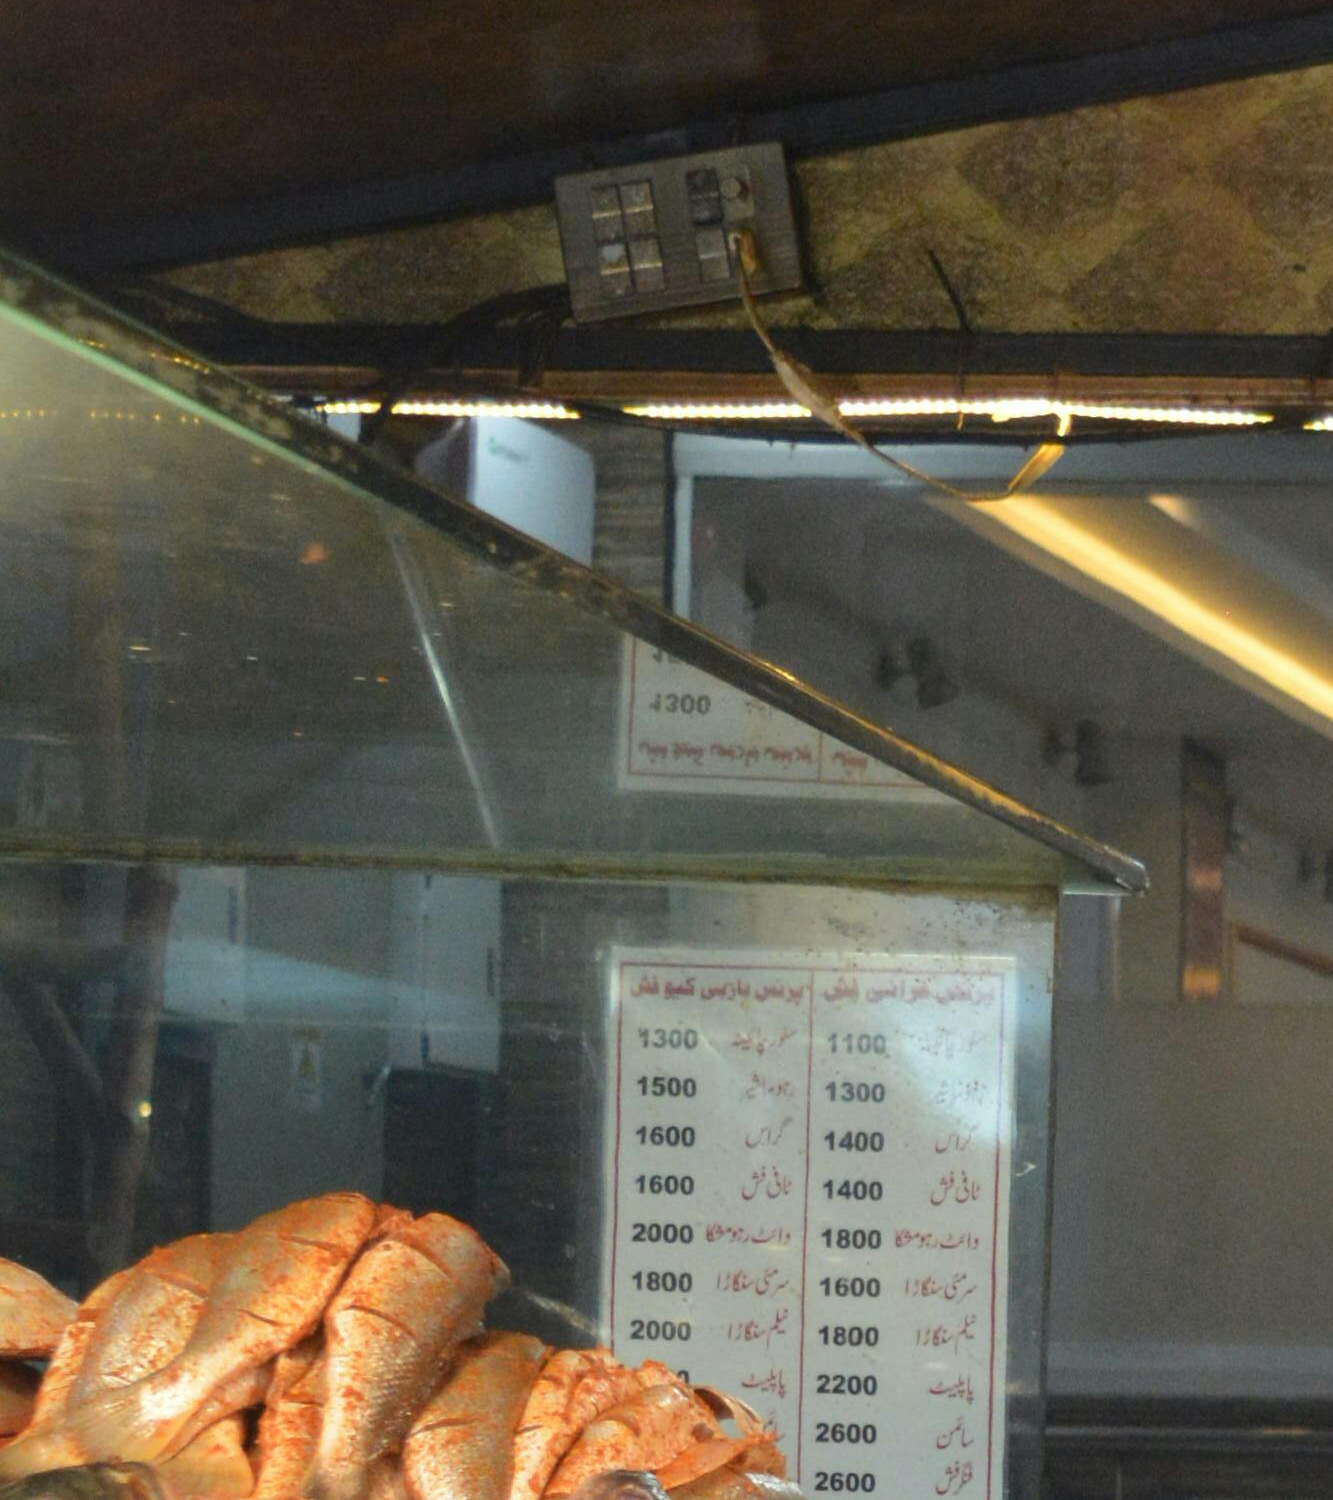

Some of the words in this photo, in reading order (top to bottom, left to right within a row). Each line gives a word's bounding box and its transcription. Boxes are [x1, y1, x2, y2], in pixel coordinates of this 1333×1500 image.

[637, 1027, 698, 1051] 1300
[827, 1031, 886, 1055] 1100
[637, 1075, 697, 1098] 1500
[825, 1081, 886, 1104] 1300
[635, 1125, 696, 1148] 1600
[824, 1130, 885, 1153] 1400
[635, 1174, 695, 1196] 1600
[823, 1179, 883, 1202] 1400
[631, 1222, 694, 1244] 2000
[821, 1228, 882, 1250] 1800
[631, 1270, 693, 1293] 1800
[819, 1277, 881, 1299] 1600
[629, 1319, 692, 1342] 2000
[818, 1325, 880, 1348] 1800
[816, 1373, 878, 1396] 2200
[815, 1422, 878, 1445] 2600
[814, 1471, 876, 1493] 2600
